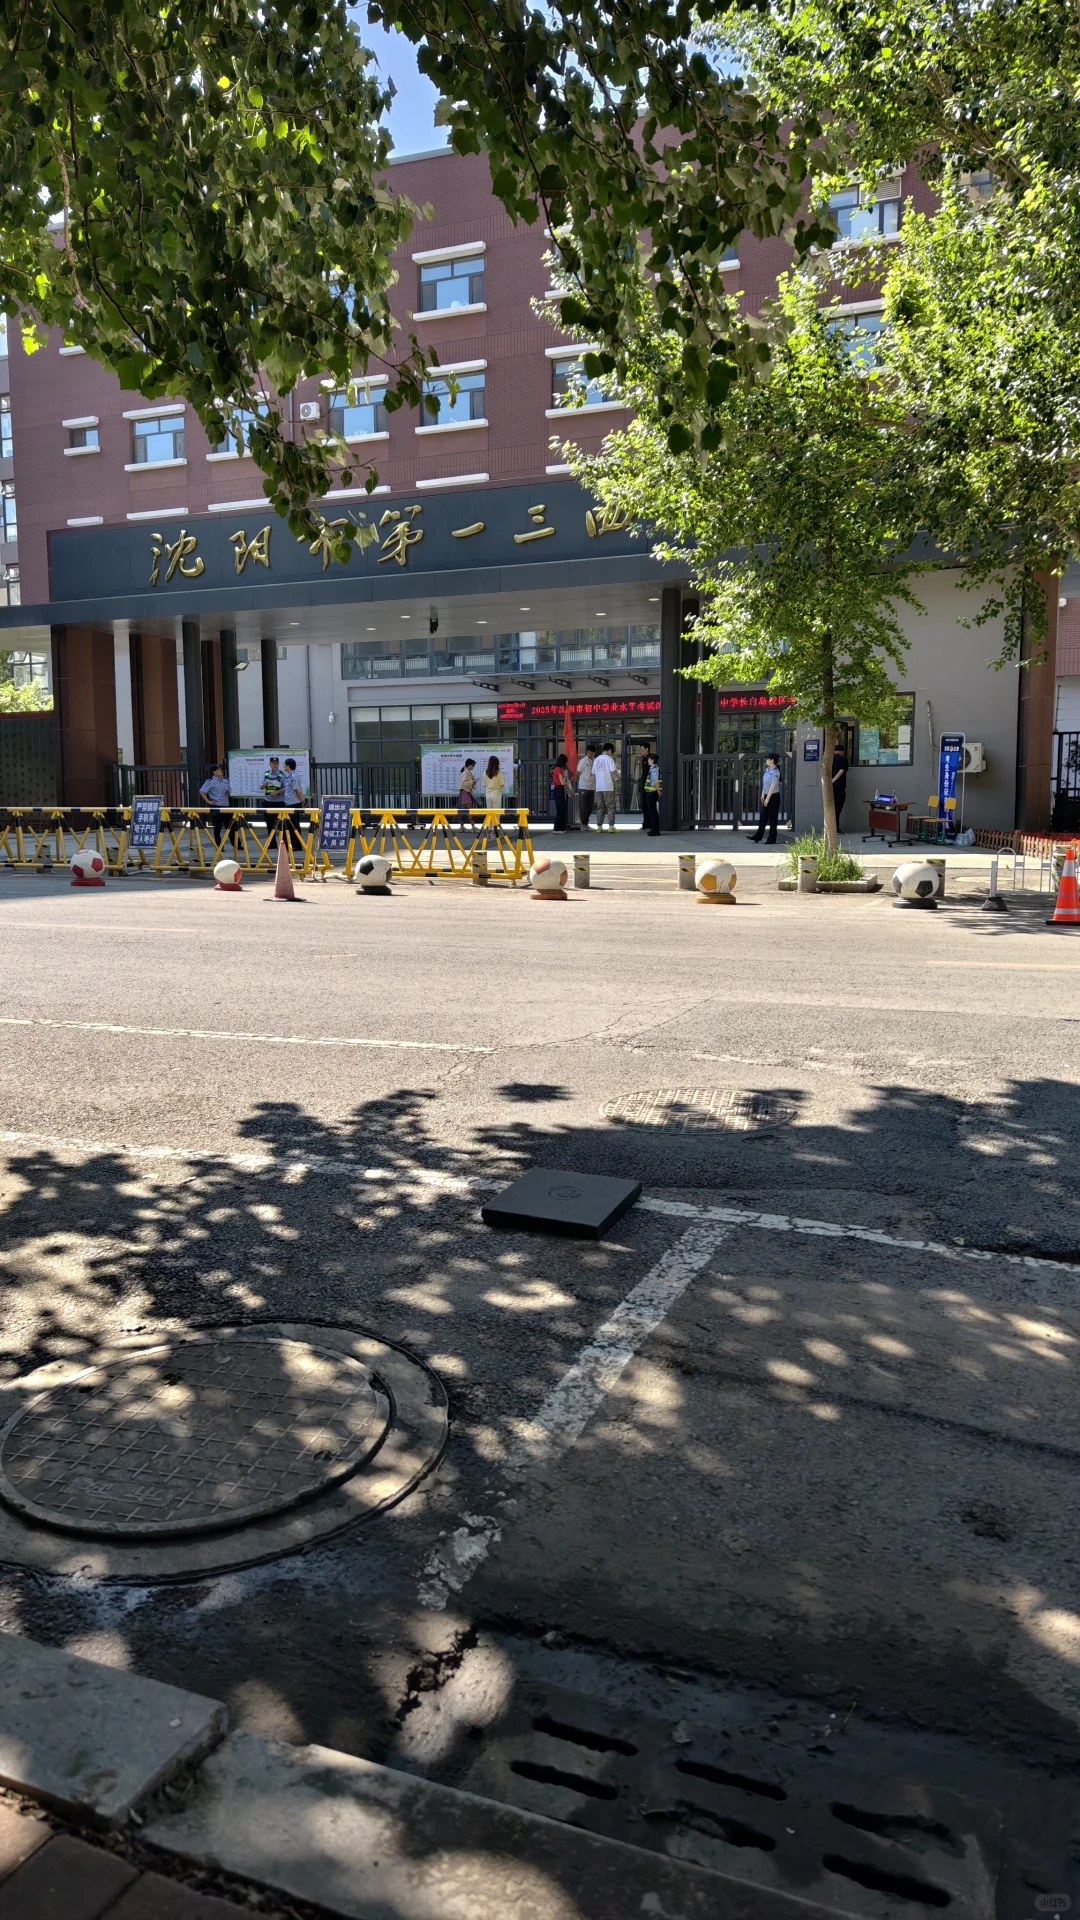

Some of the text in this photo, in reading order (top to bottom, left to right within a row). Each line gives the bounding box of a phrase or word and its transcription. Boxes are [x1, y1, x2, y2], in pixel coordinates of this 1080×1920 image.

[137, 813, 155, 822] 手机等
[324, 812, 348, 820] 准考证
[134, 824, 157, 834] 电子产品
[323, 821, 347, 829] 身份证
[323, 830, 348, 838] 考试工作
